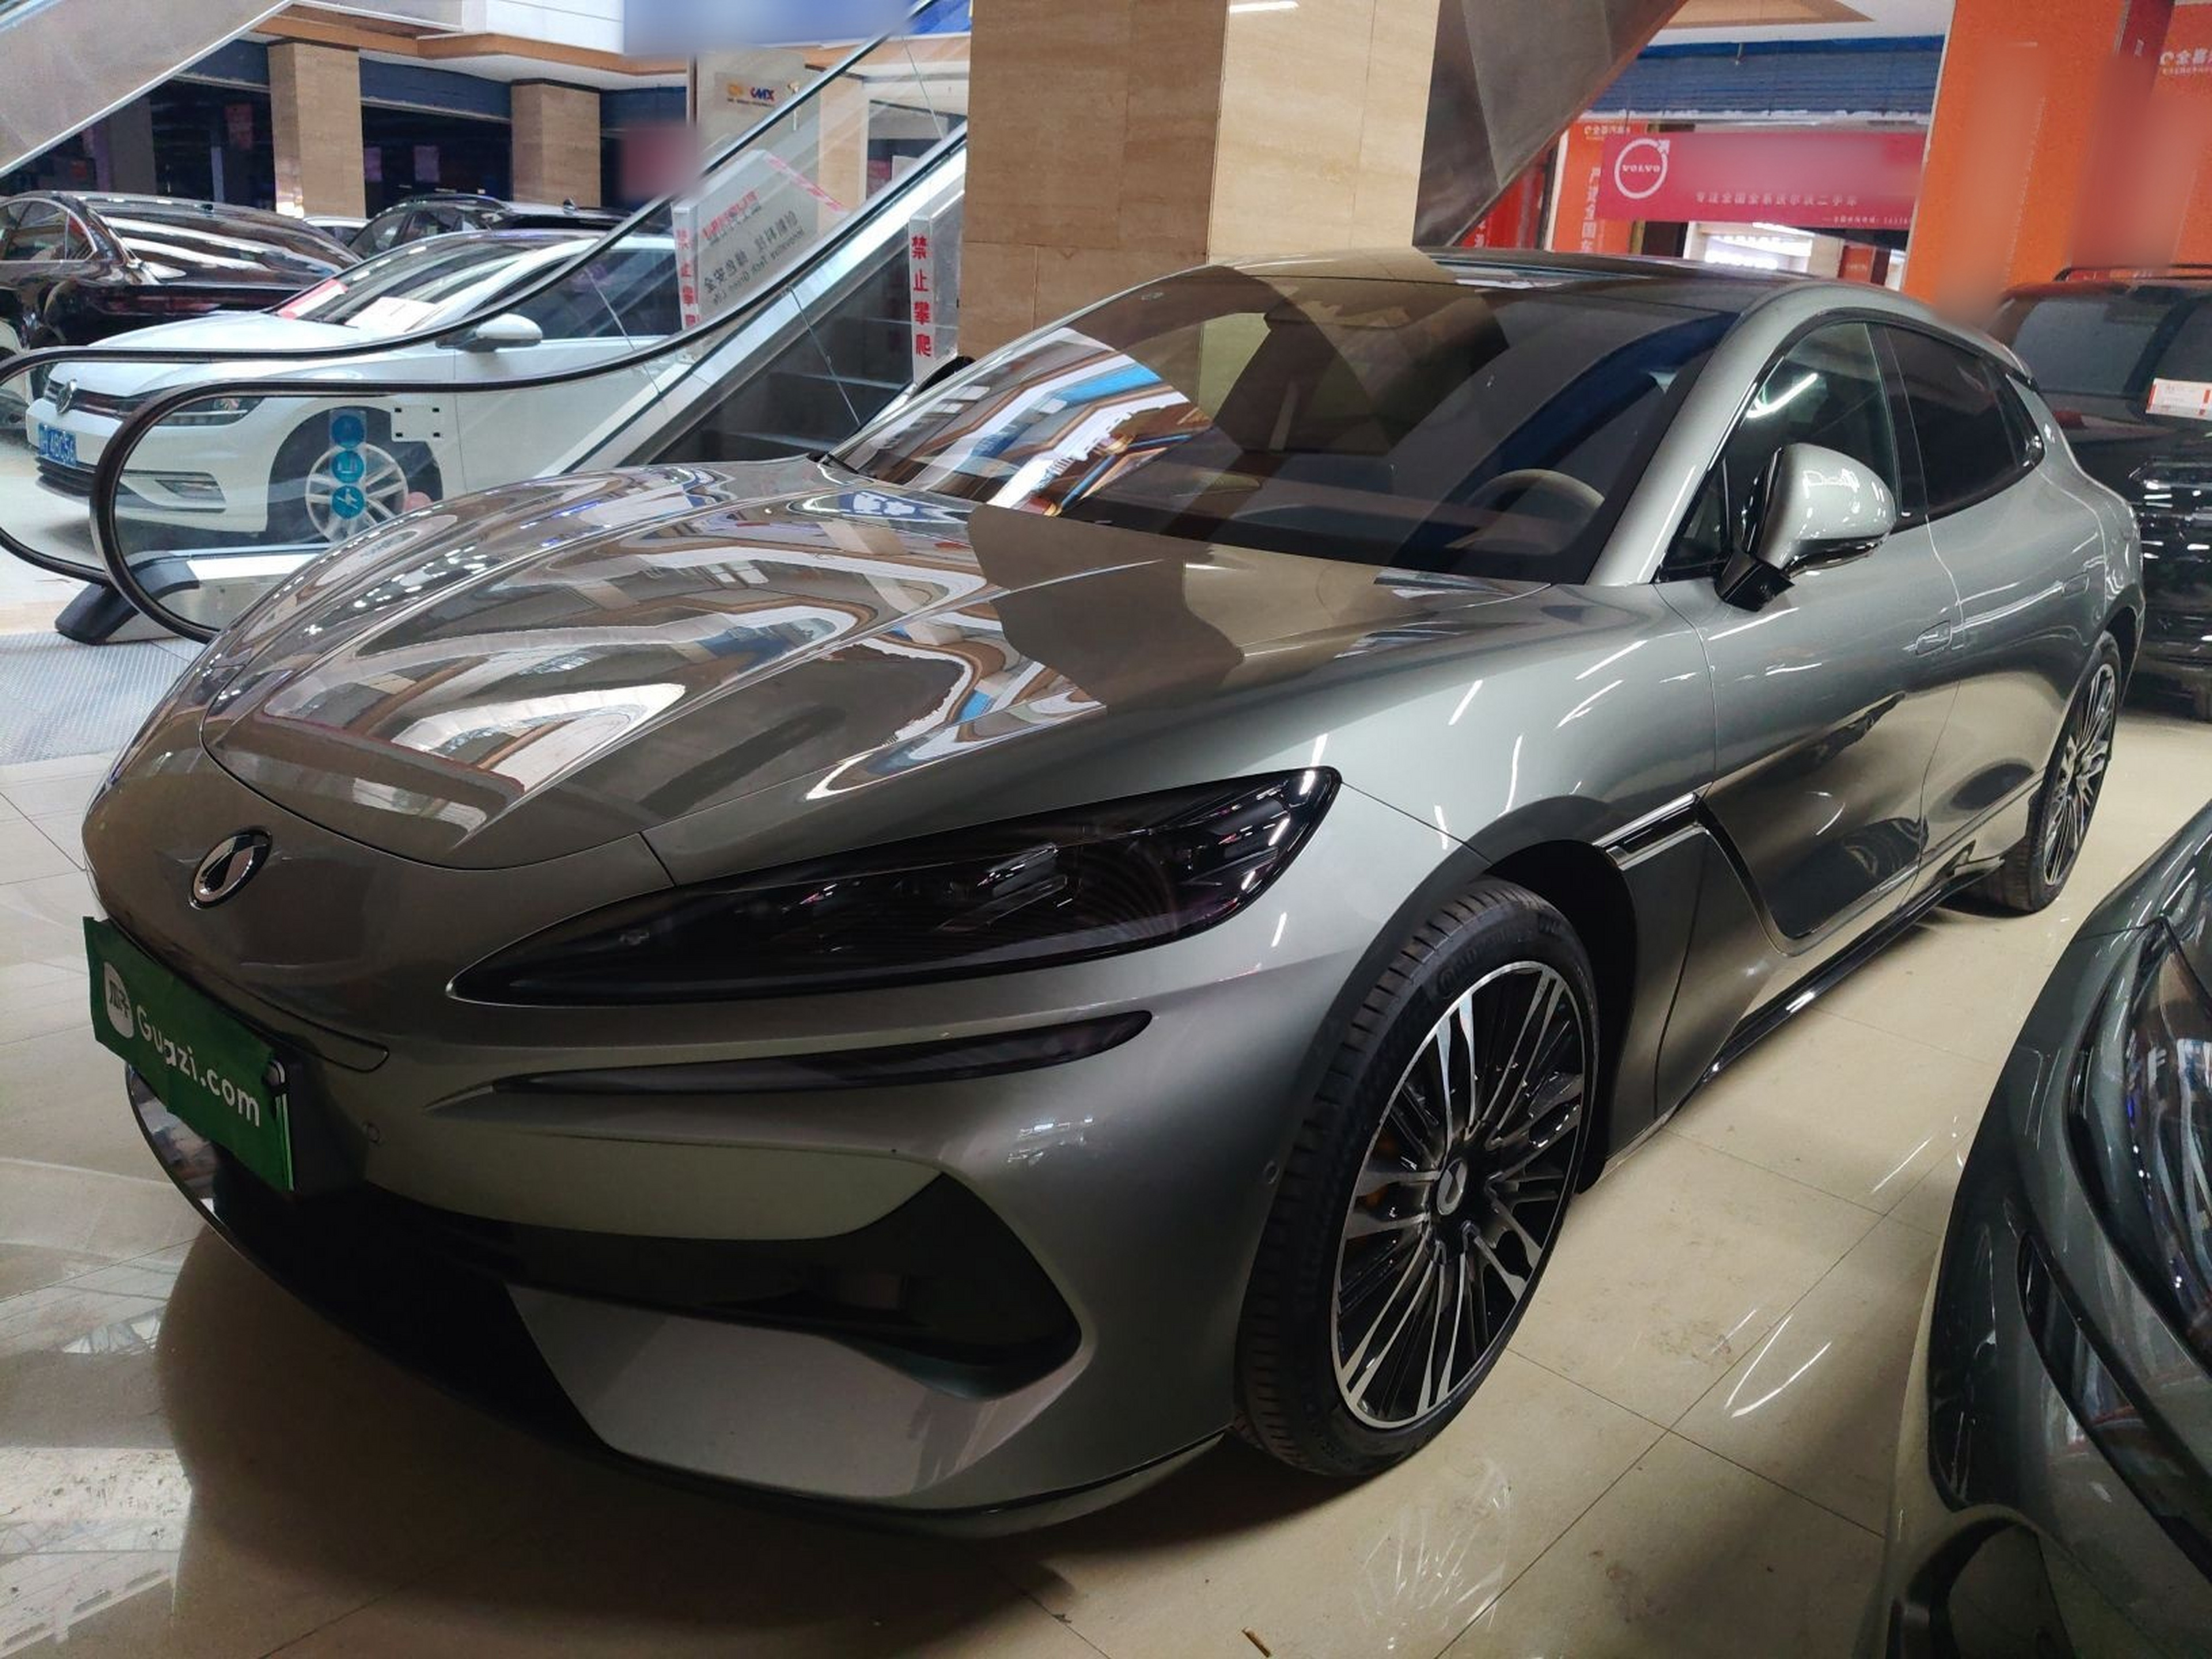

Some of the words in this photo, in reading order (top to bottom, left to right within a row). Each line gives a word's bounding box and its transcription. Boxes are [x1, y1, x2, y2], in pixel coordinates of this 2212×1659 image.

[912, 236, 931, 357] 禁止攀爬
[137, 1005, 259, 1127] Guazi.com
